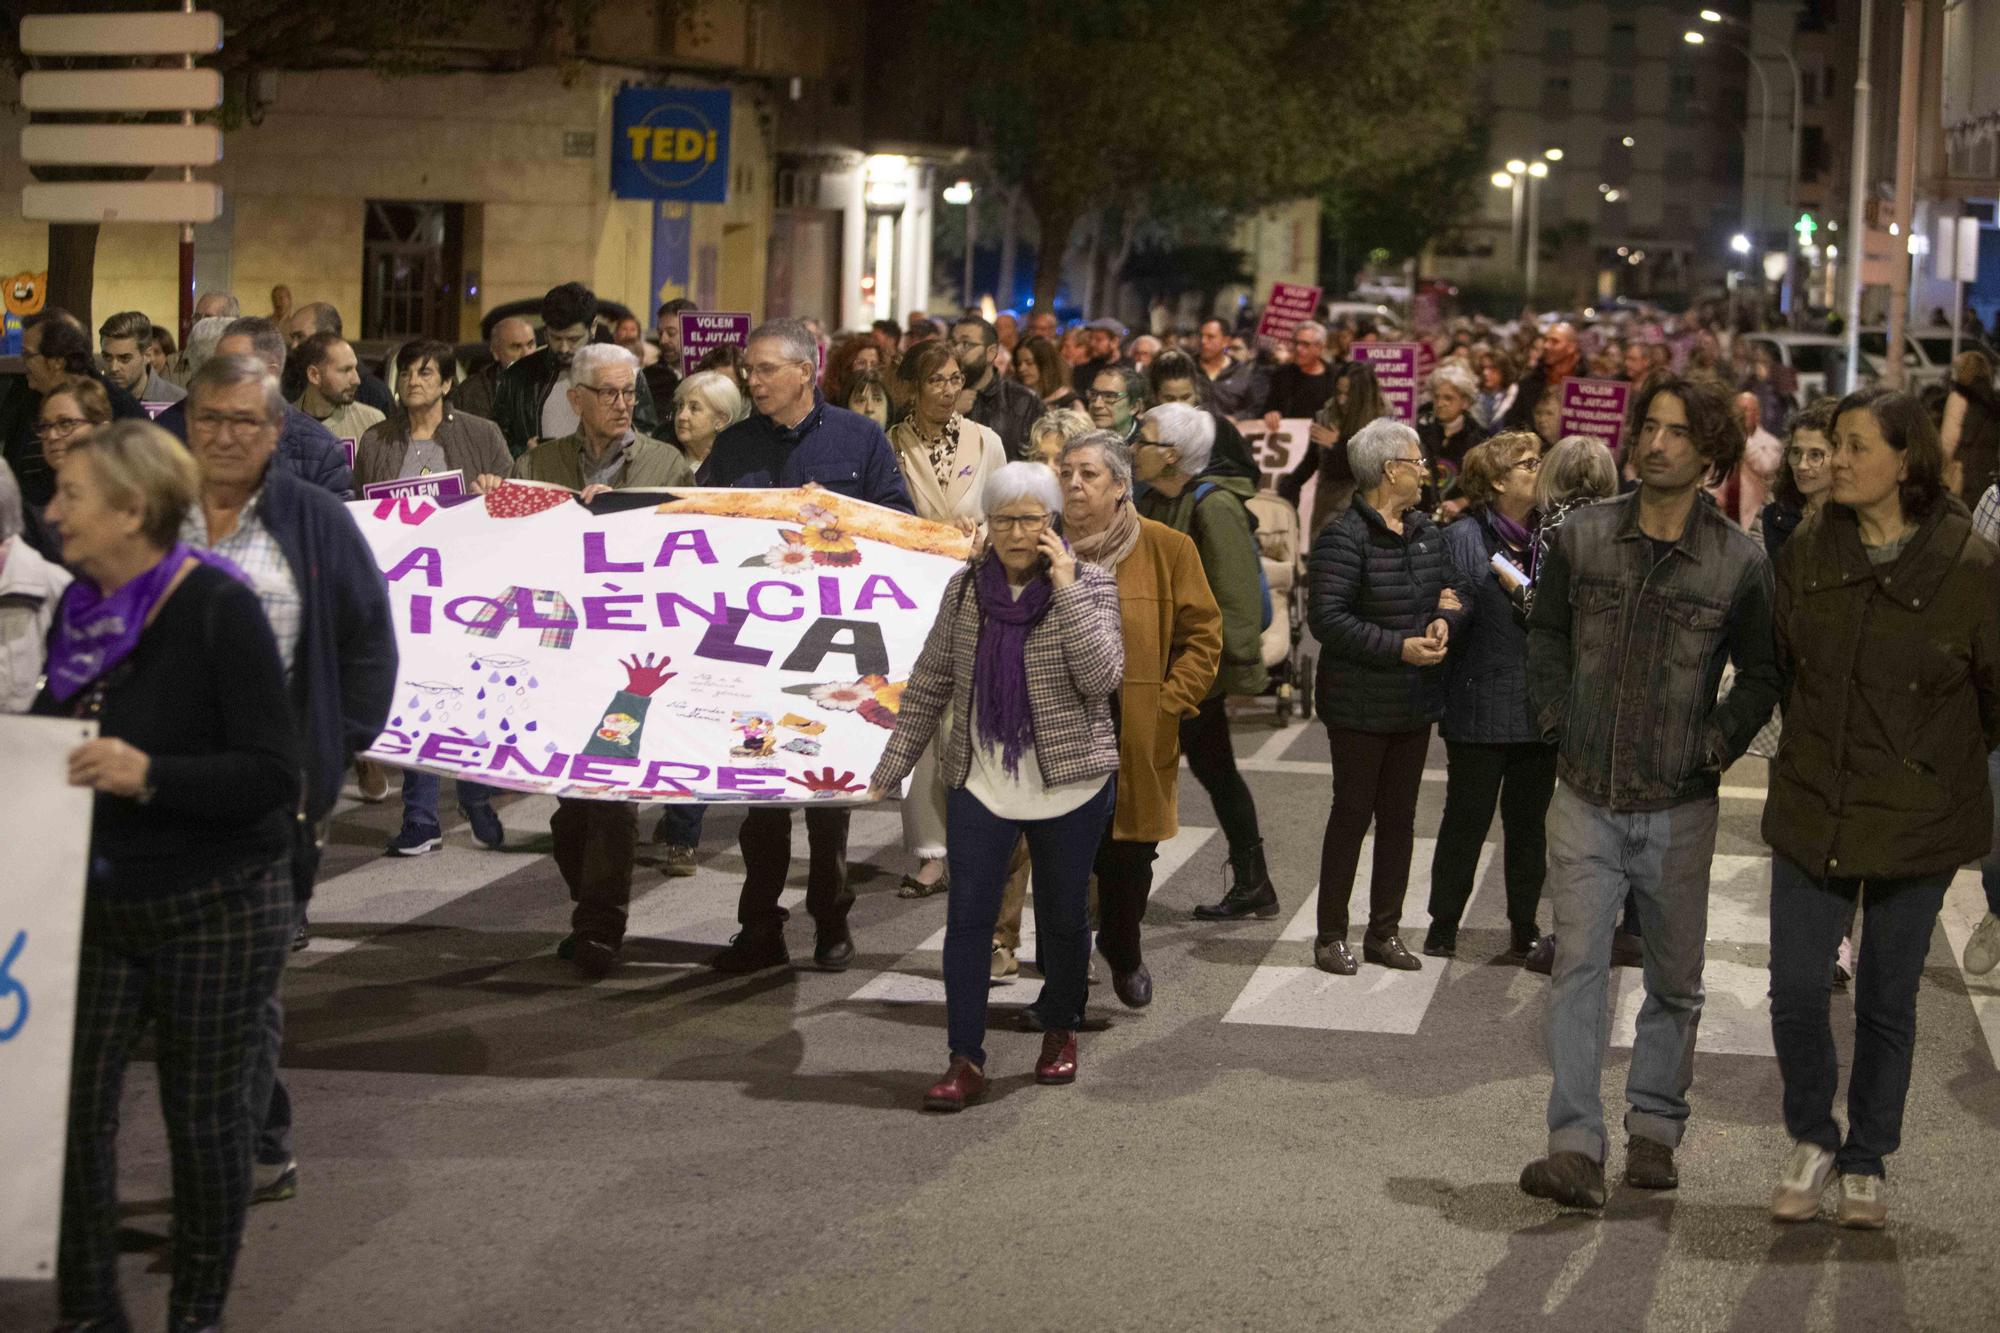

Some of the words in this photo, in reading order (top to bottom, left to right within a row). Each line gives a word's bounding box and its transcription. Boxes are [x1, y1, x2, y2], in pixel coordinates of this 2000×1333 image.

[696, 317, 734, 329] VOLEM
[690, 332, 702, 342] EL
[705, 333, 741, 343] JUTJAT
[684, 346, 697, 356] DE
[1366, 348, 1403, 359] VOLEM
[1579, 384, 1615, 397] VOLEM
[1584, 398, 1619, 409] JUTJAT
[389, 483, 440, 500] VOLEM
[583, 529, 719, 574] LA
[410, 574, 918, 635] IOLÈNCIA
